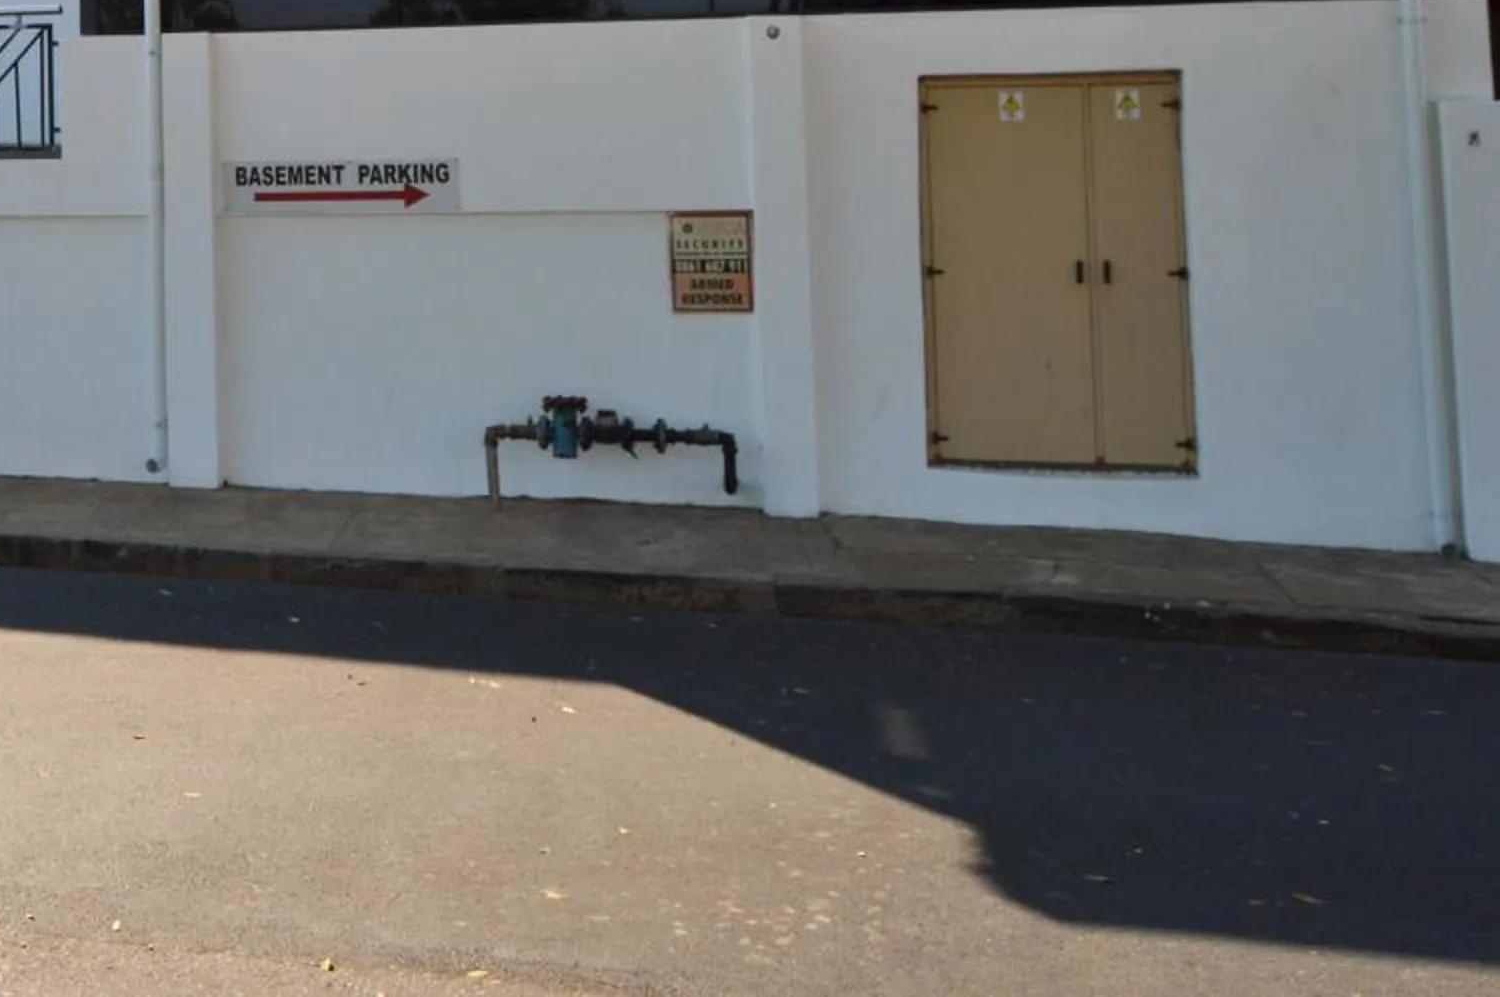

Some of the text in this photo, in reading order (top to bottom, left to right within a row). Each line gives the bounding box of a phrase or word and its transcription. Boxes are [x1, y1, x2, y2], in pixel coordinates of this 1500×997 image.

[235, 162, 450, 186] BASEMENT PARKING
[690, 278, 735, 290] ARMED
[681, 293, 743, 305] RESPONSE
